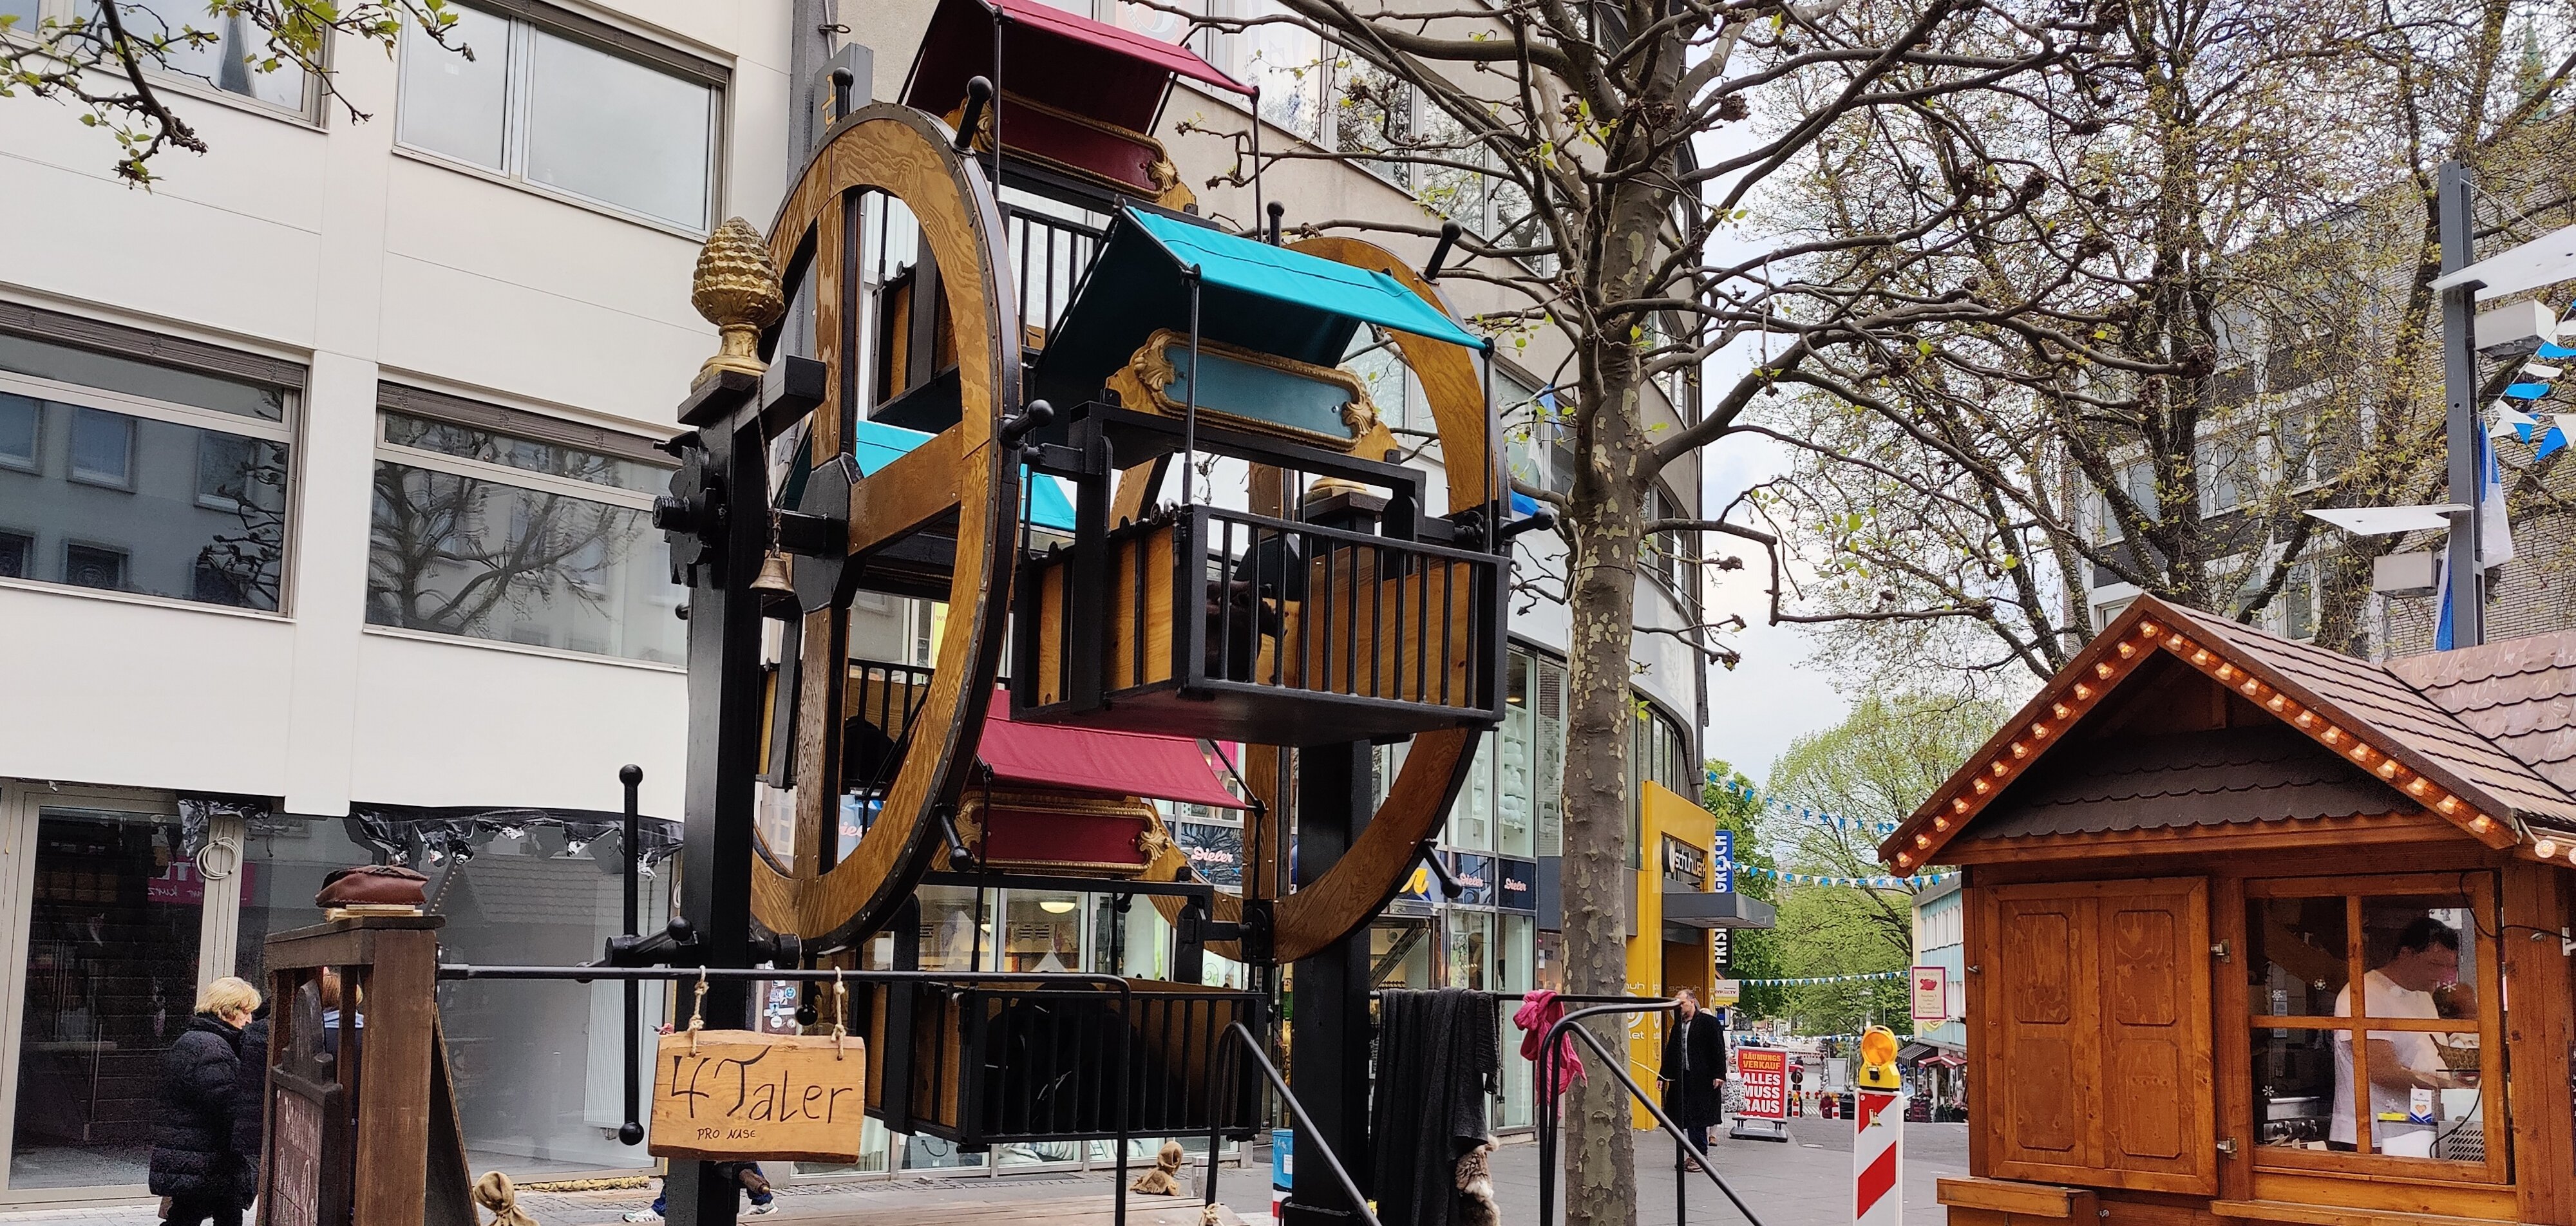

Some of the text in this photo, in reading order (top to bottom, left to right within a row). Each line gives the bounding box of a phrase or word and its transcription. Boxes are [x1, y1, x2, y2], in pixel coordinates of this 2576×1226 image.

[1743, 1052, 1781, 1062] RÄUMUNGS
[1743, 1061, 1781, 1070] VERKAUF
[1743, 1072, 1781, 1086] ALLES
[671, 1055, 711, 1118] 4
[1744, 1086, 1780, 1099] MUSS
[697, 1129, 756, 1140] PRO NASE
